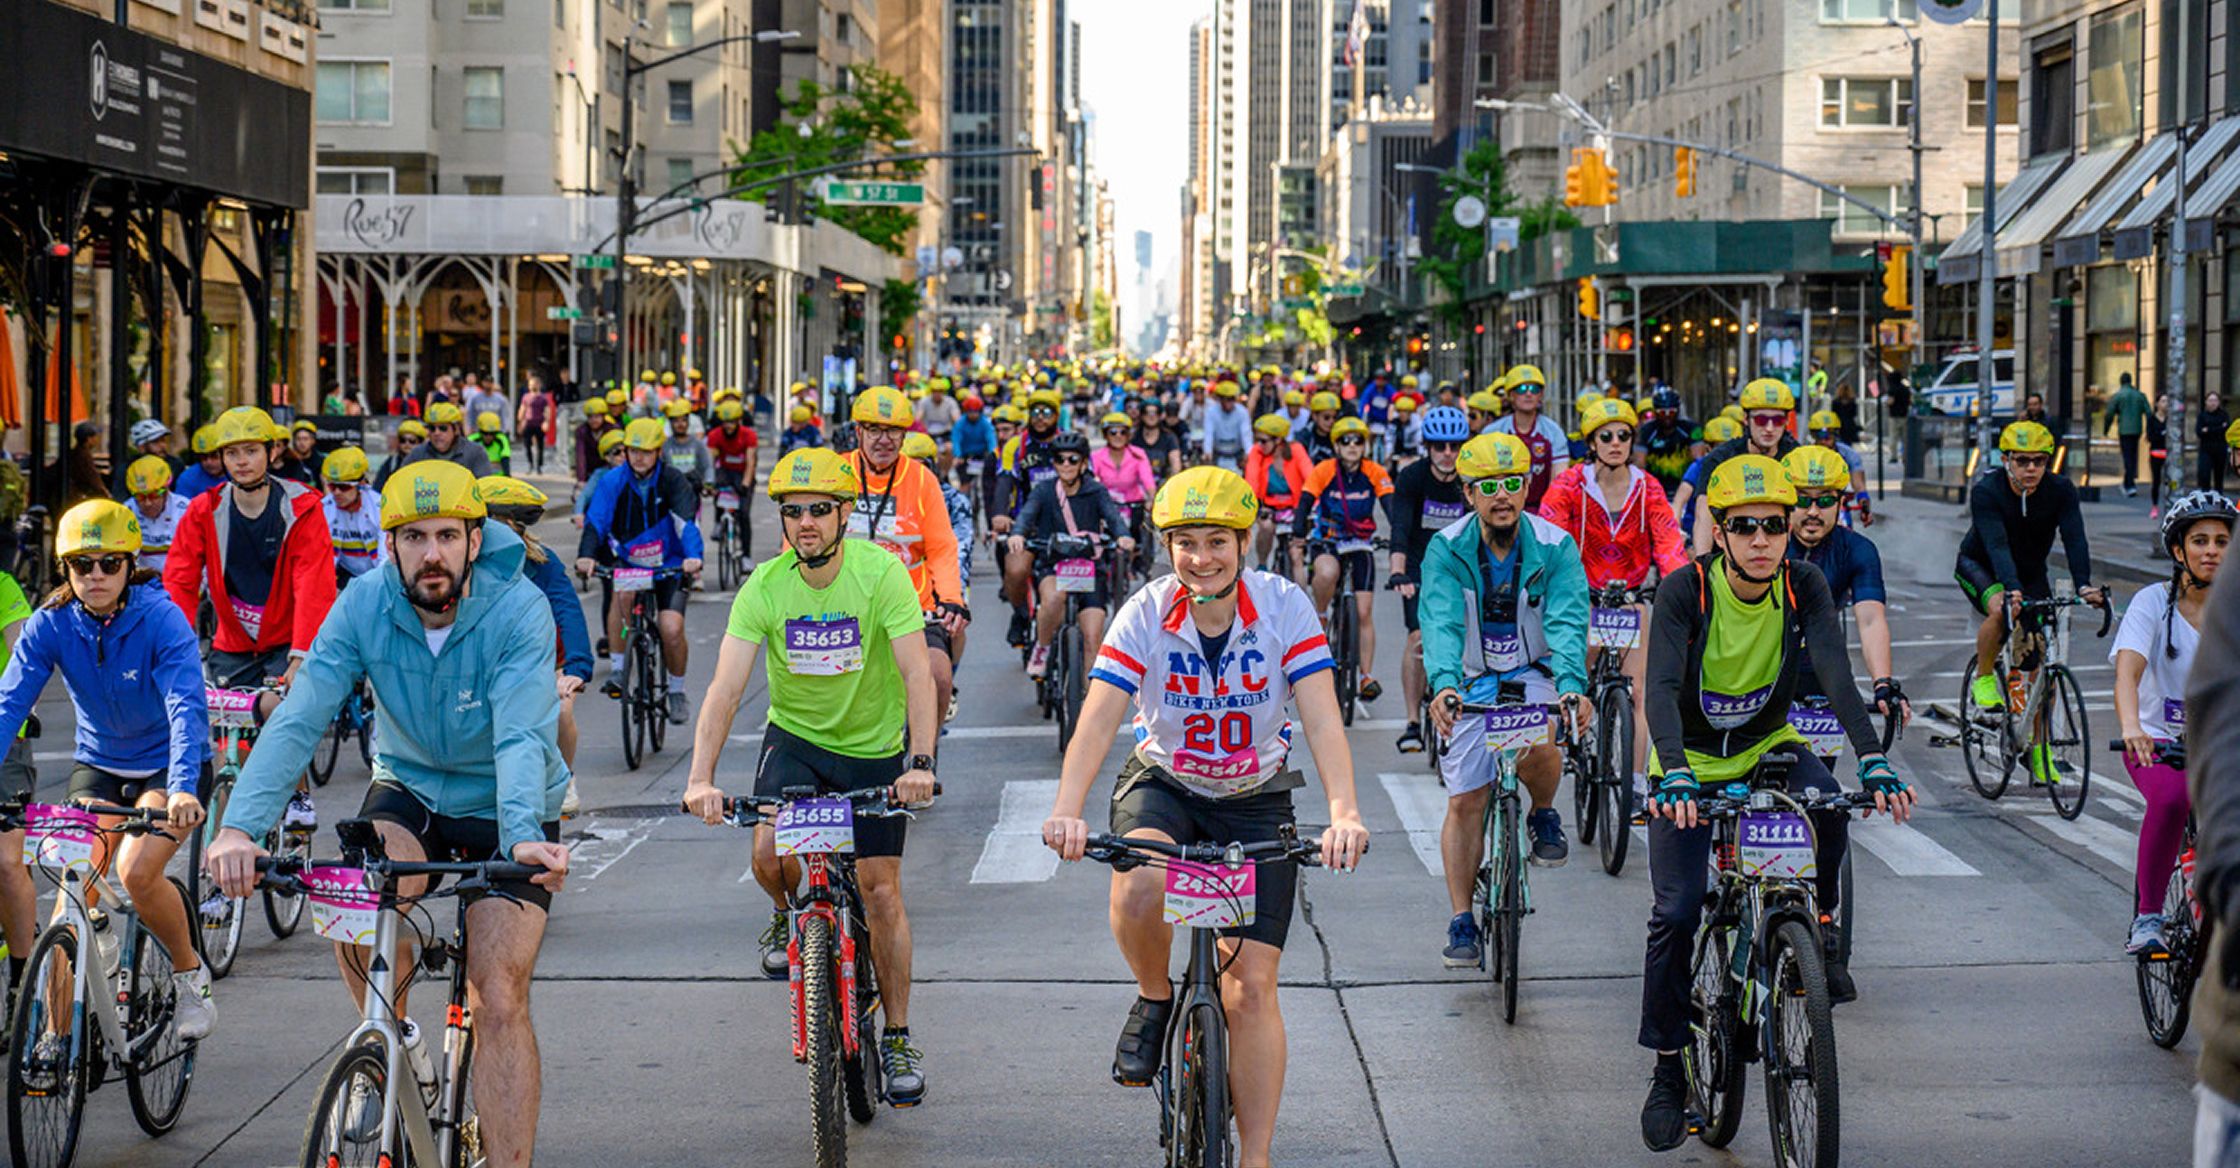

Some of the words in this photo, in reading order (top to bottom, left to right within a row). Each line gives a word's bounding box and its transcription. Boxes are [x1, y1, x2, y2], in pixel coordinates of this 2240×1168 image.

[852, 187, 864, 198] W
[867, 187, 882, 198] 57
[415, 488, 439, 498] BORO
[416, 504, 439, 515] TOUR
[793, 628, 854, 647] 35653
[1484, 638, 1518, 653] 3377
[1165, 649, 1268, 695] NYC
[1166, 692, 1197, 707] BIKE
[1234, 690, 1269, 706] YORK
[1491, 711, 1544, 729] 33770
[1794, 717, 1839, 732] 33771
[1183, 711, 1252, 755] 20
[1182, 758, 1253, 777] 24547
[781, 807, 845, 827] 35655
[1746, 824, 1806, 843] 31111
[1173, 872, 1249, 895] 24547
